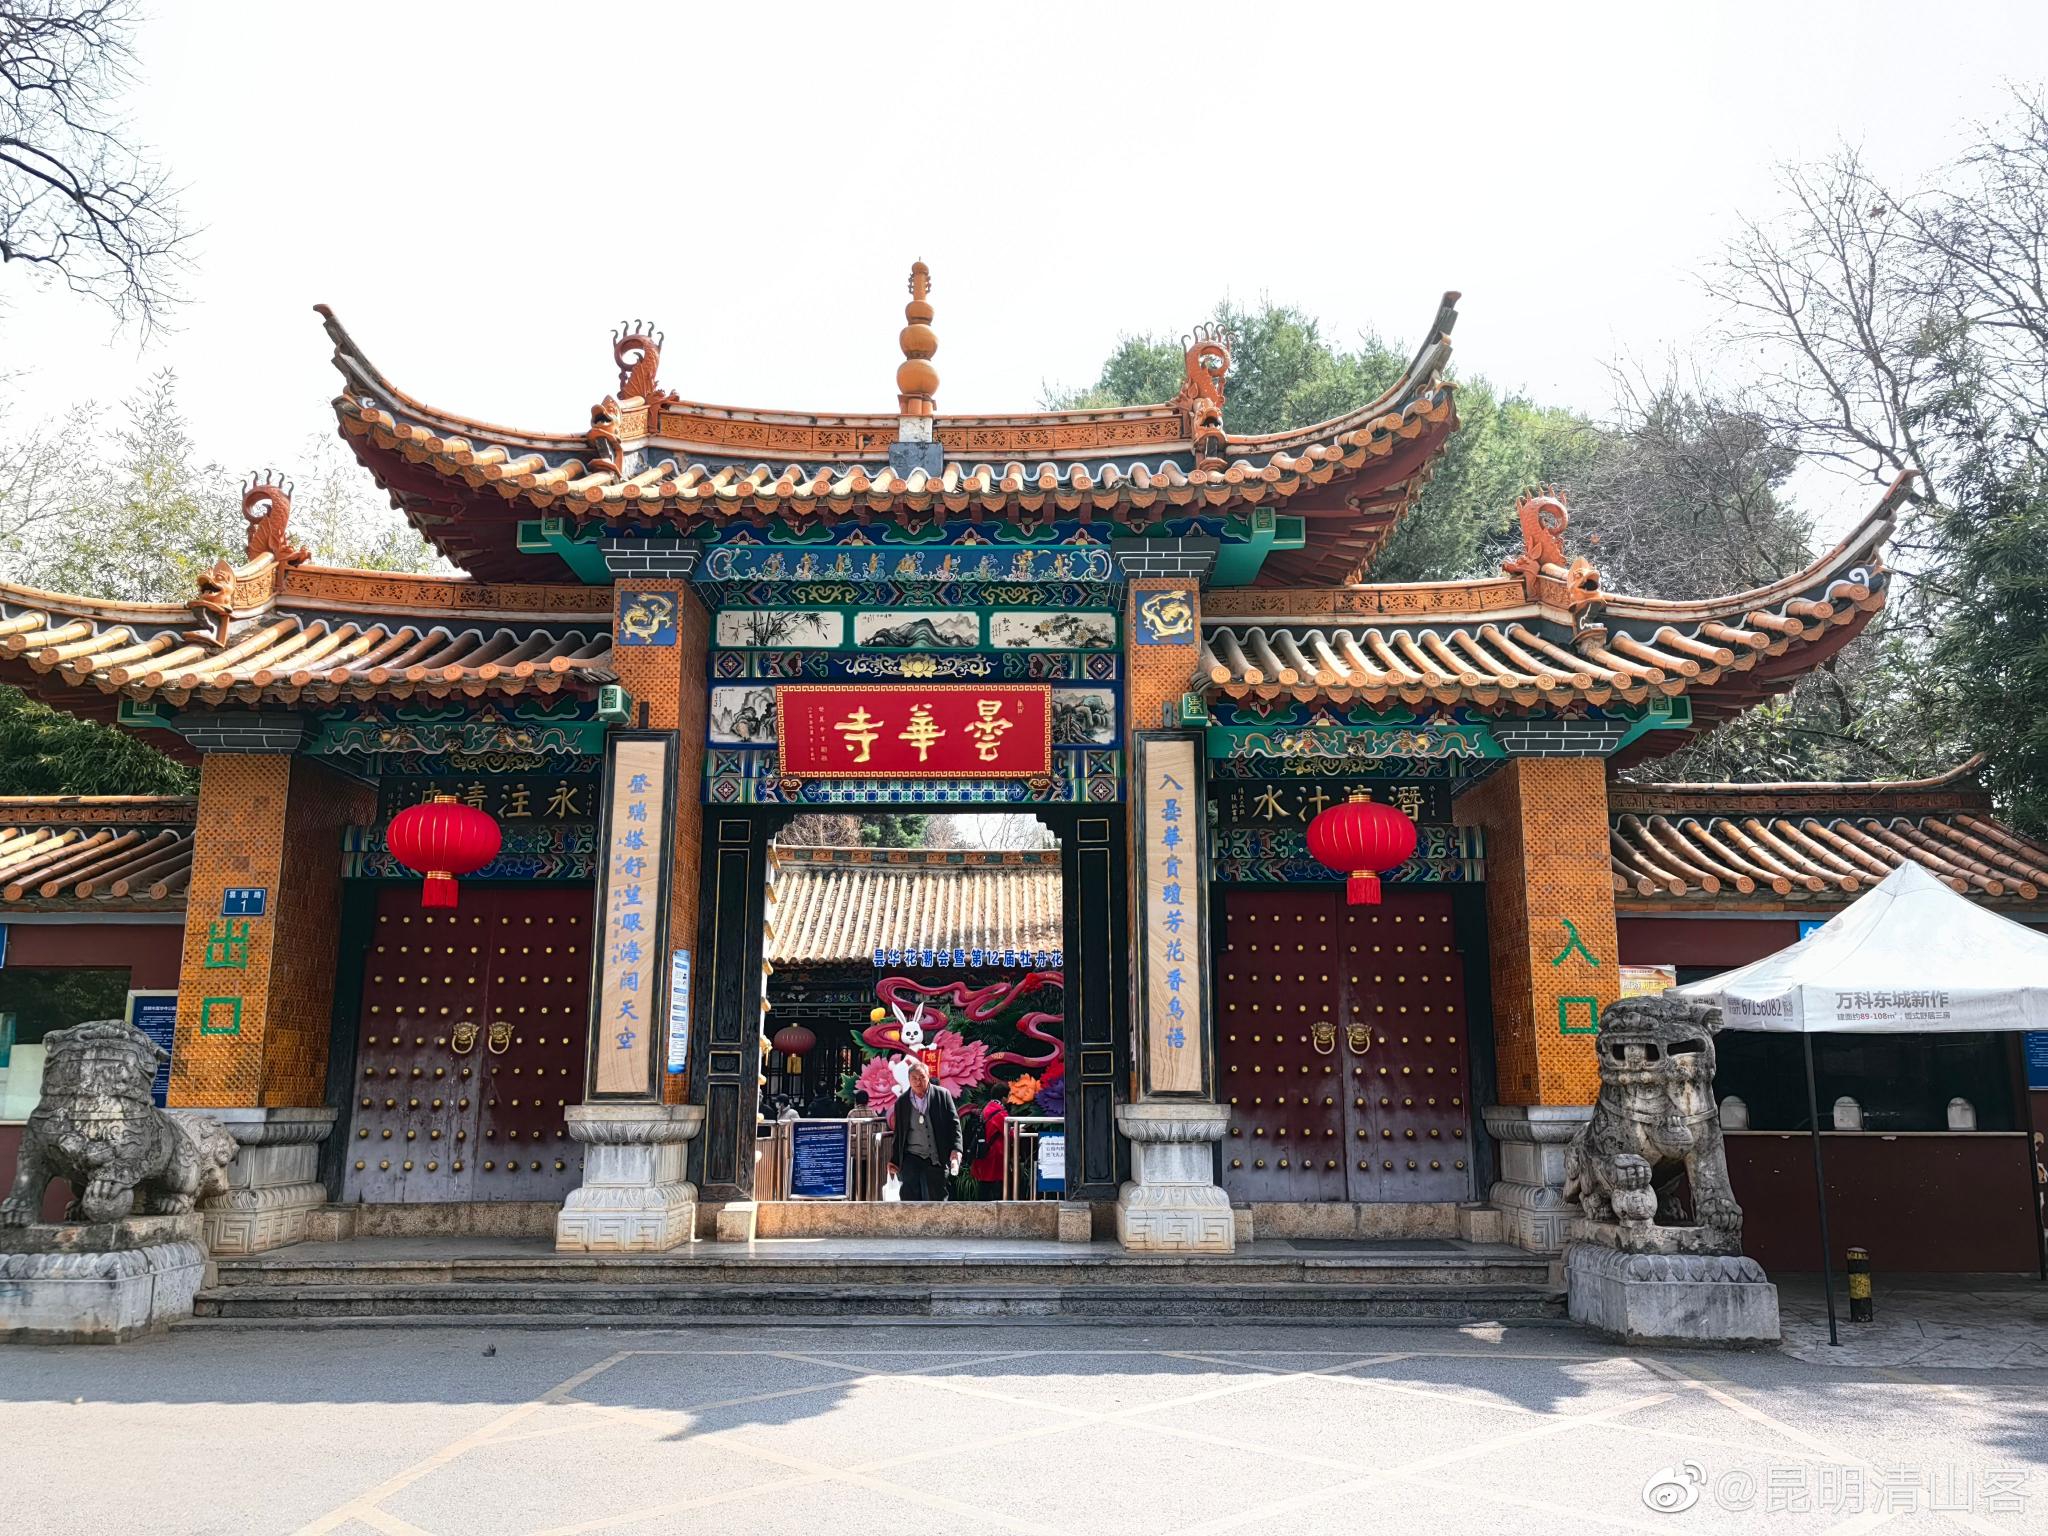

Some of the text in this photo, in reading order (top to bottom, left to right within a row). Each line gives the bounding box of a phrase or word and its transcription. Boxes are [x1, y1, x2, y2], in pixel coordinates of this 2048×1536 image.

[241, 900, 246, 912] 1
[200, 919, 250, 1036] 出口
[1551, 919, 1600, 1035] 入口
[1742, 999, 1783, 1016] 67156082
[1835, 991, 1949, 1010] 万科东城新作
